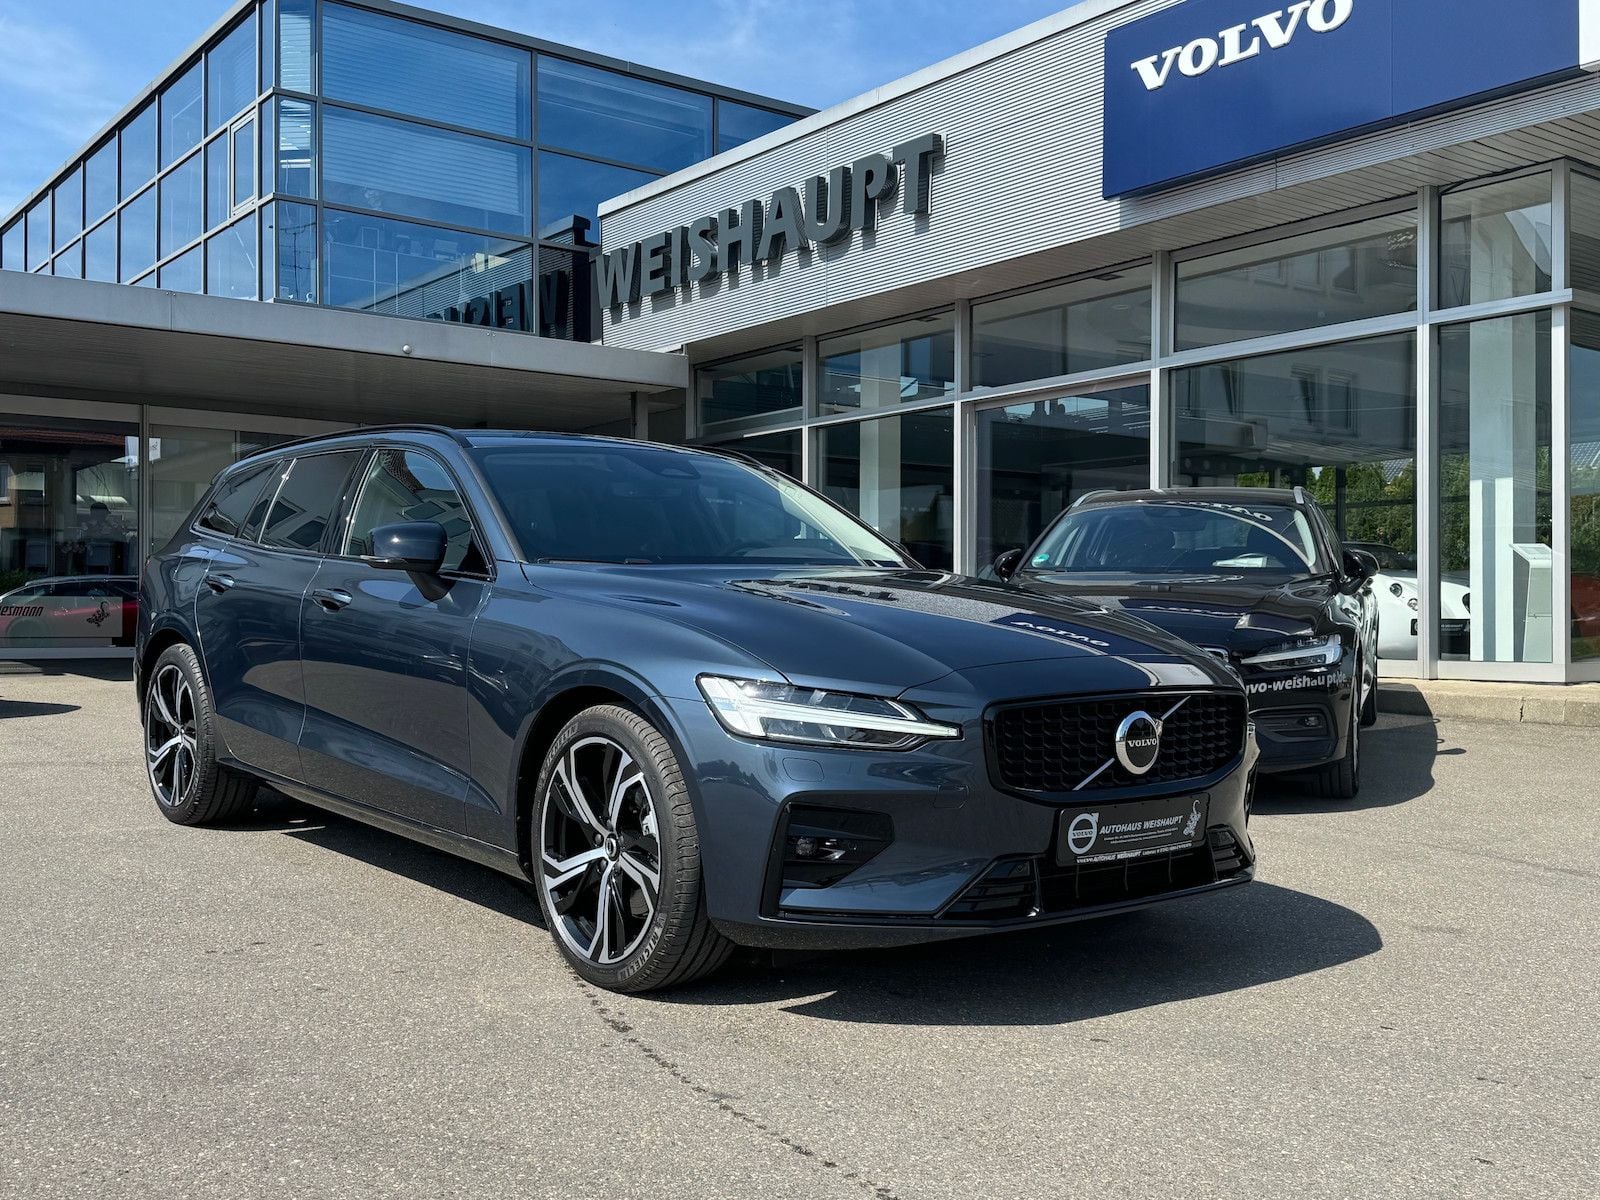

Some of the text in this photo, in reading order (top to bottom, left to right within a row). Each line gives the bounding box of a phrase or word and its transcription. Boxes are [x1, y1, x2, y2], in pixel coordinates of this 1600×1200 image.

[1131, 0, 1353, 90] VOLVO
[596, 132, 946, 310] WEISHAUPT
[1127, 738, 1157, 748] VOLVO
[1099, 822, 1142, 835] AUTOHAUS
[1143, 815, 1183, 829] WEISHAUPT
[617, 926, 664, 981] MICHELIN
